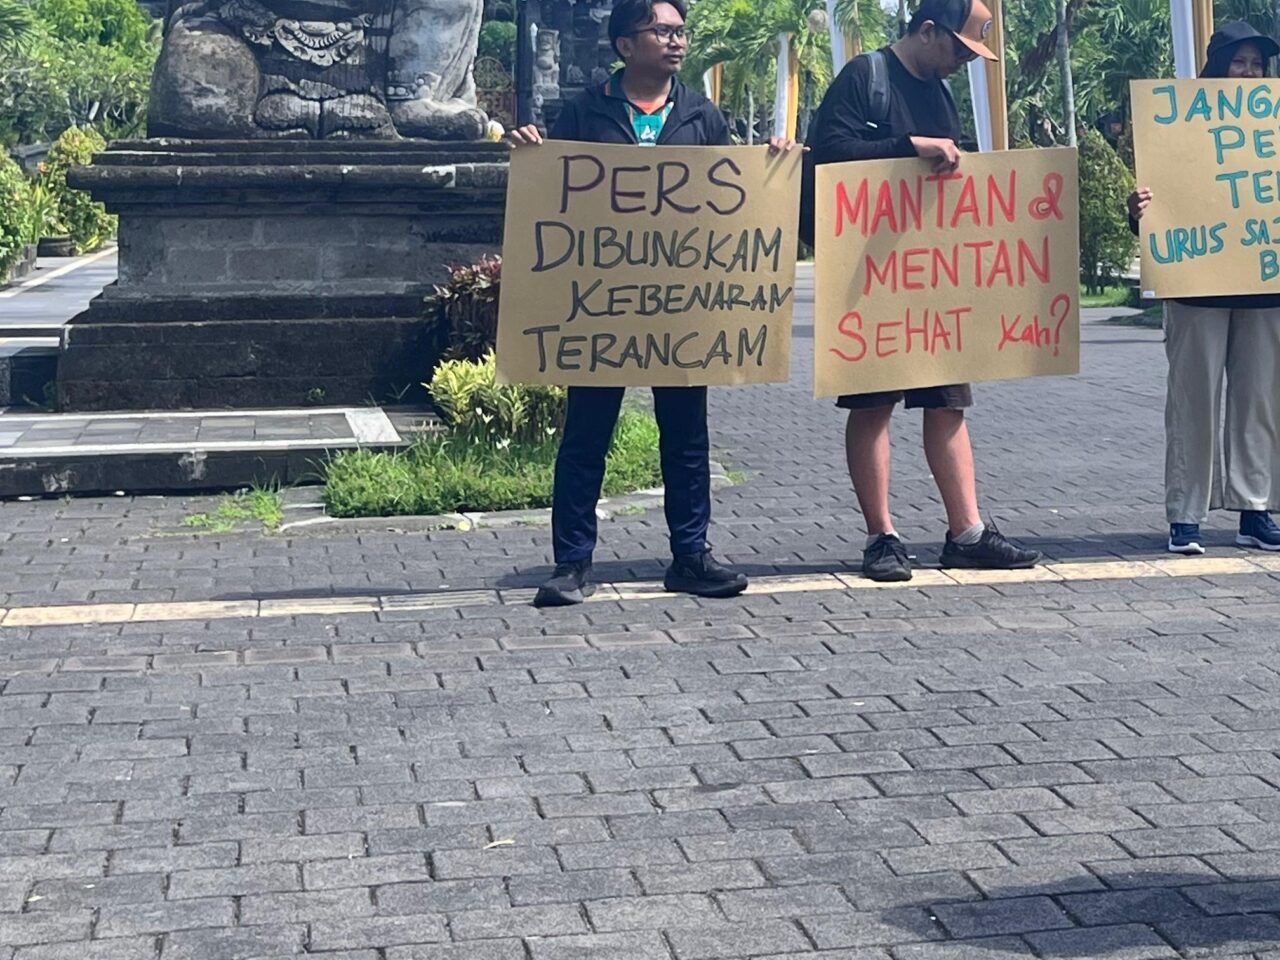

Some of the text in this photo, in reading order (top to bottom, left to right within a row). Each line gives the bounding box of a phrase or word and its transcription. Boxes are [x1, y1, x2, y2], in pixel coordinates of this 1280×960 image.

[558, 154, 748, 216] PERS
[834, 169, 1017, 238] MANTAN
[531, 221, 782, 274] DIBUNGKAM
[863, 236, 1051, 296] MENTAN
[1149, 222, 1228, 265] URUS
[567, 279, 793, 323] KEBENARAN
[523, 324, 769, 373] TERANCAM
[829, 306, 972, 362] SEHAT
